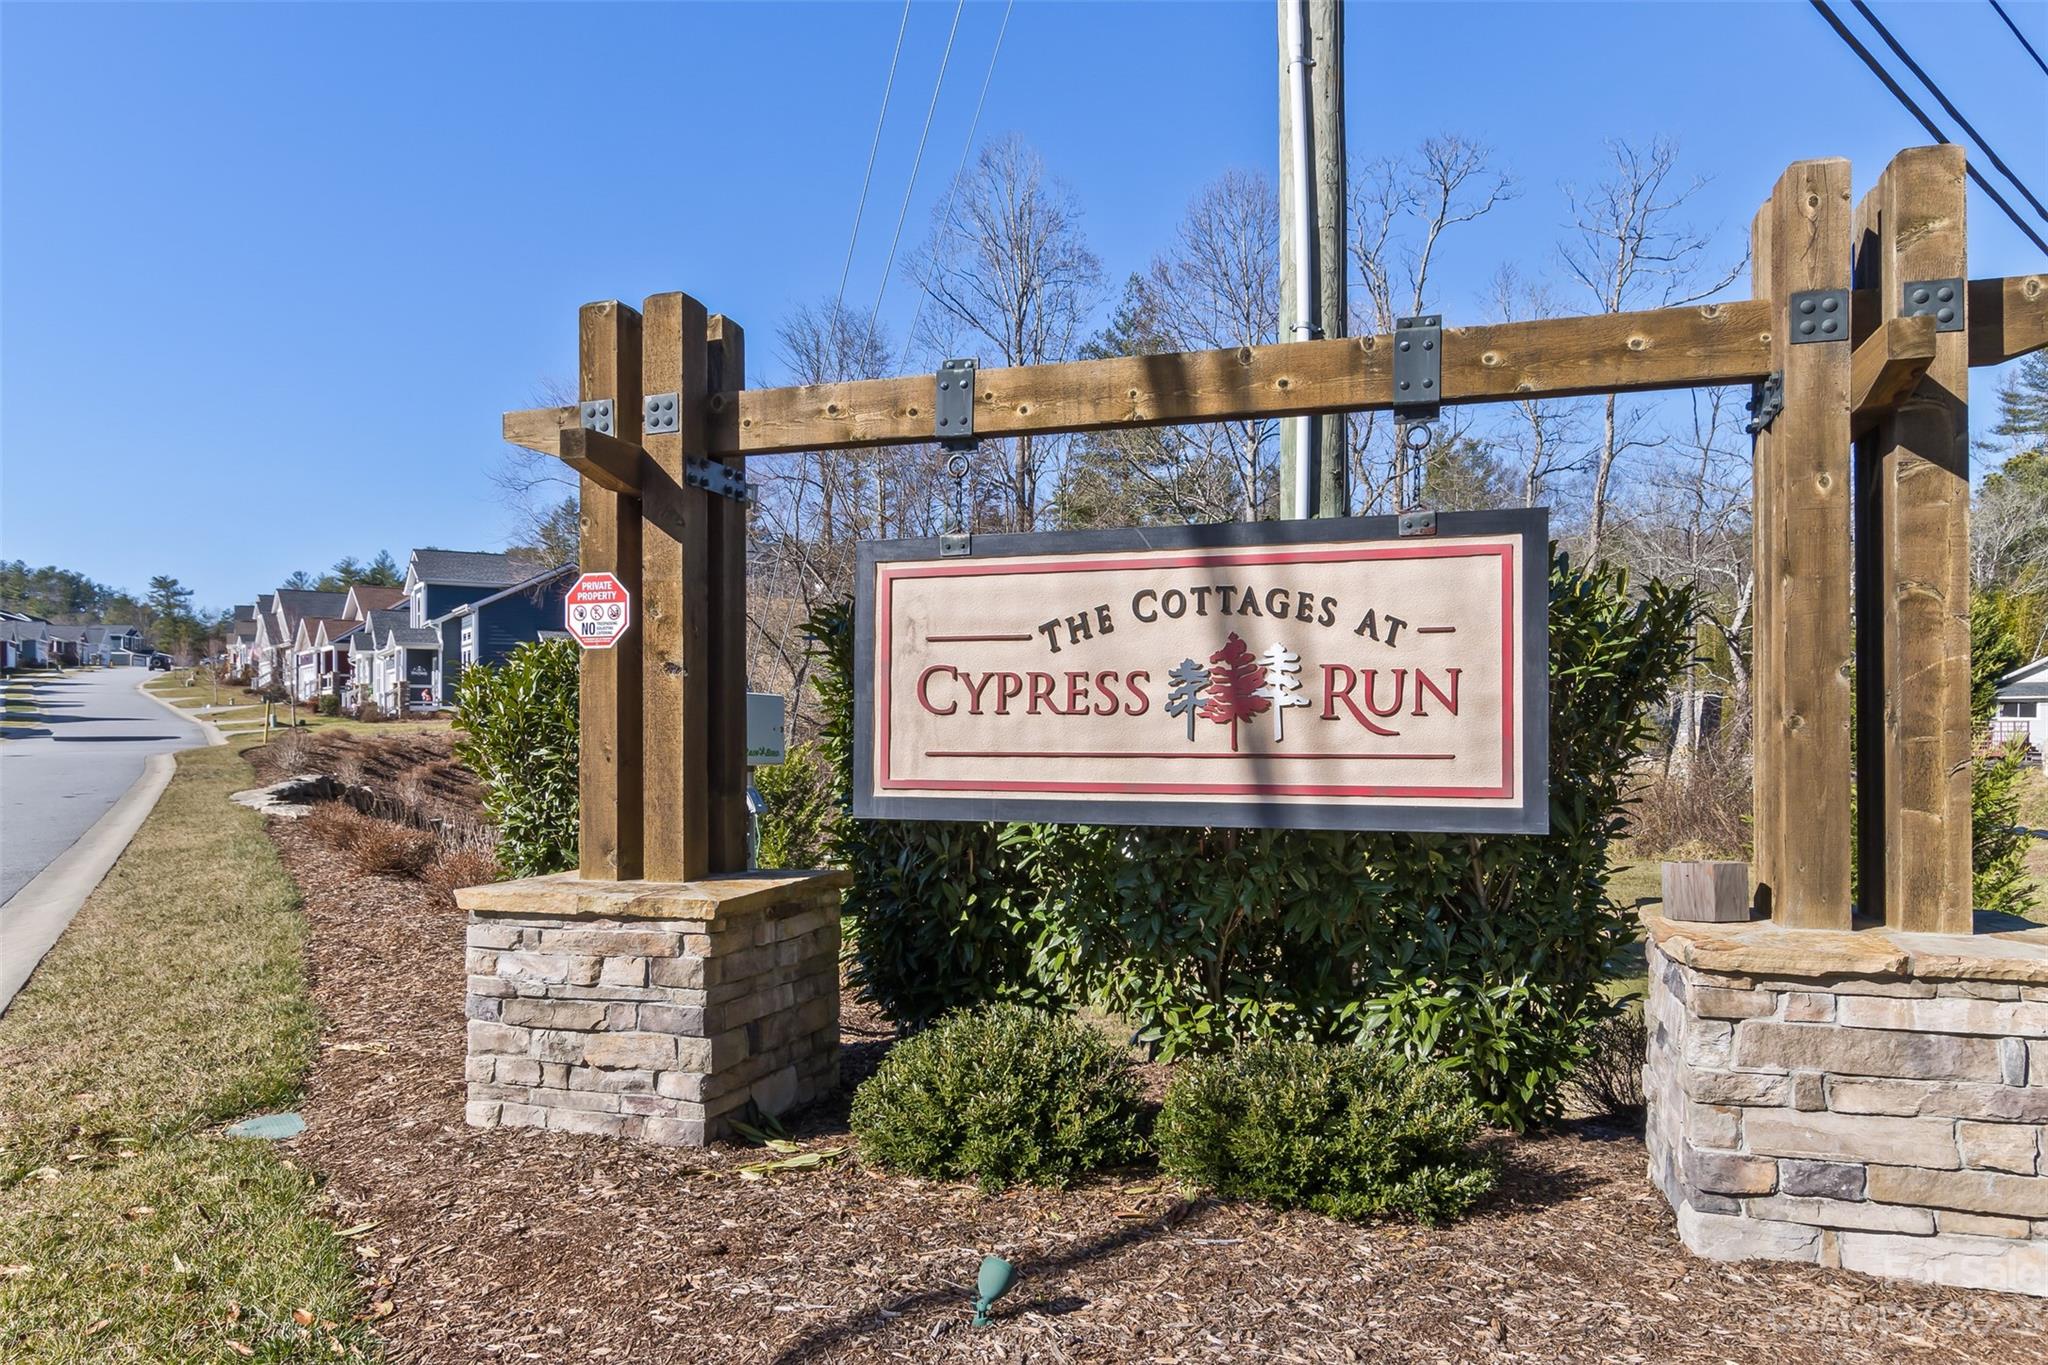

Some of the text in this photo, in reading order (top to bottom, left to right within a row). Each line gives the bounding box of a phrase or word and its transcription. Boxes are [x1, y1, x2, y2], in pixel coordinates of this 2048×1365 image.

[582, 580, 613, 590] PRIVATE
[577, 591, 617, 601] PROPERTY
[1038, 585, 1407, 654] THE COTTAGES AT
[581, 622, 596, 636] NO
[916, 663, 1463, 736] CYPRESS RUN
